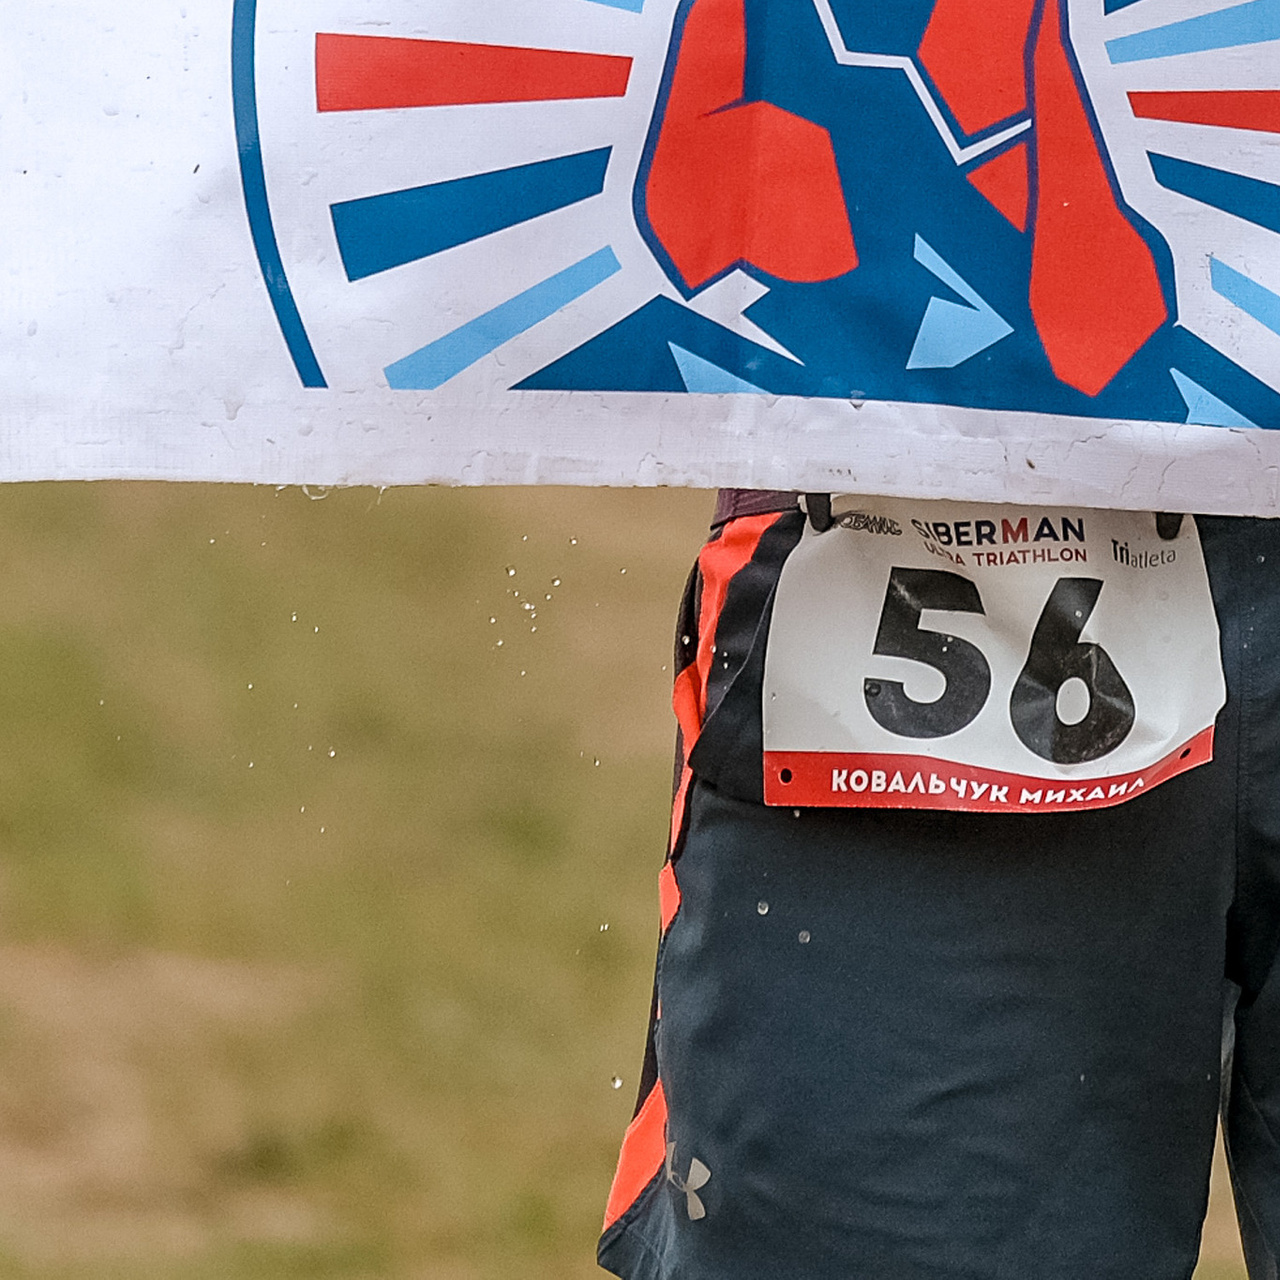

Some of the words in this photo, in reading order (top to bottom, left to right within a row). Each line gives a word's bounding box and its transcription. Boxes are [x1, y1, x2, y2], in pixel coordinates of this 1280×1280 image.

[911, 516, 1085, 547] SIBERMAN
[972, 548, 1087, 568] TRIATHLON
[1111, 538, 1176, 570] Triatleta
[864, 565, 1136, 765] 56
[831, 768, 1009, 804] КОВАЛЬЧУК
[1018, 777, 1145, 805] МИХАИЛ
